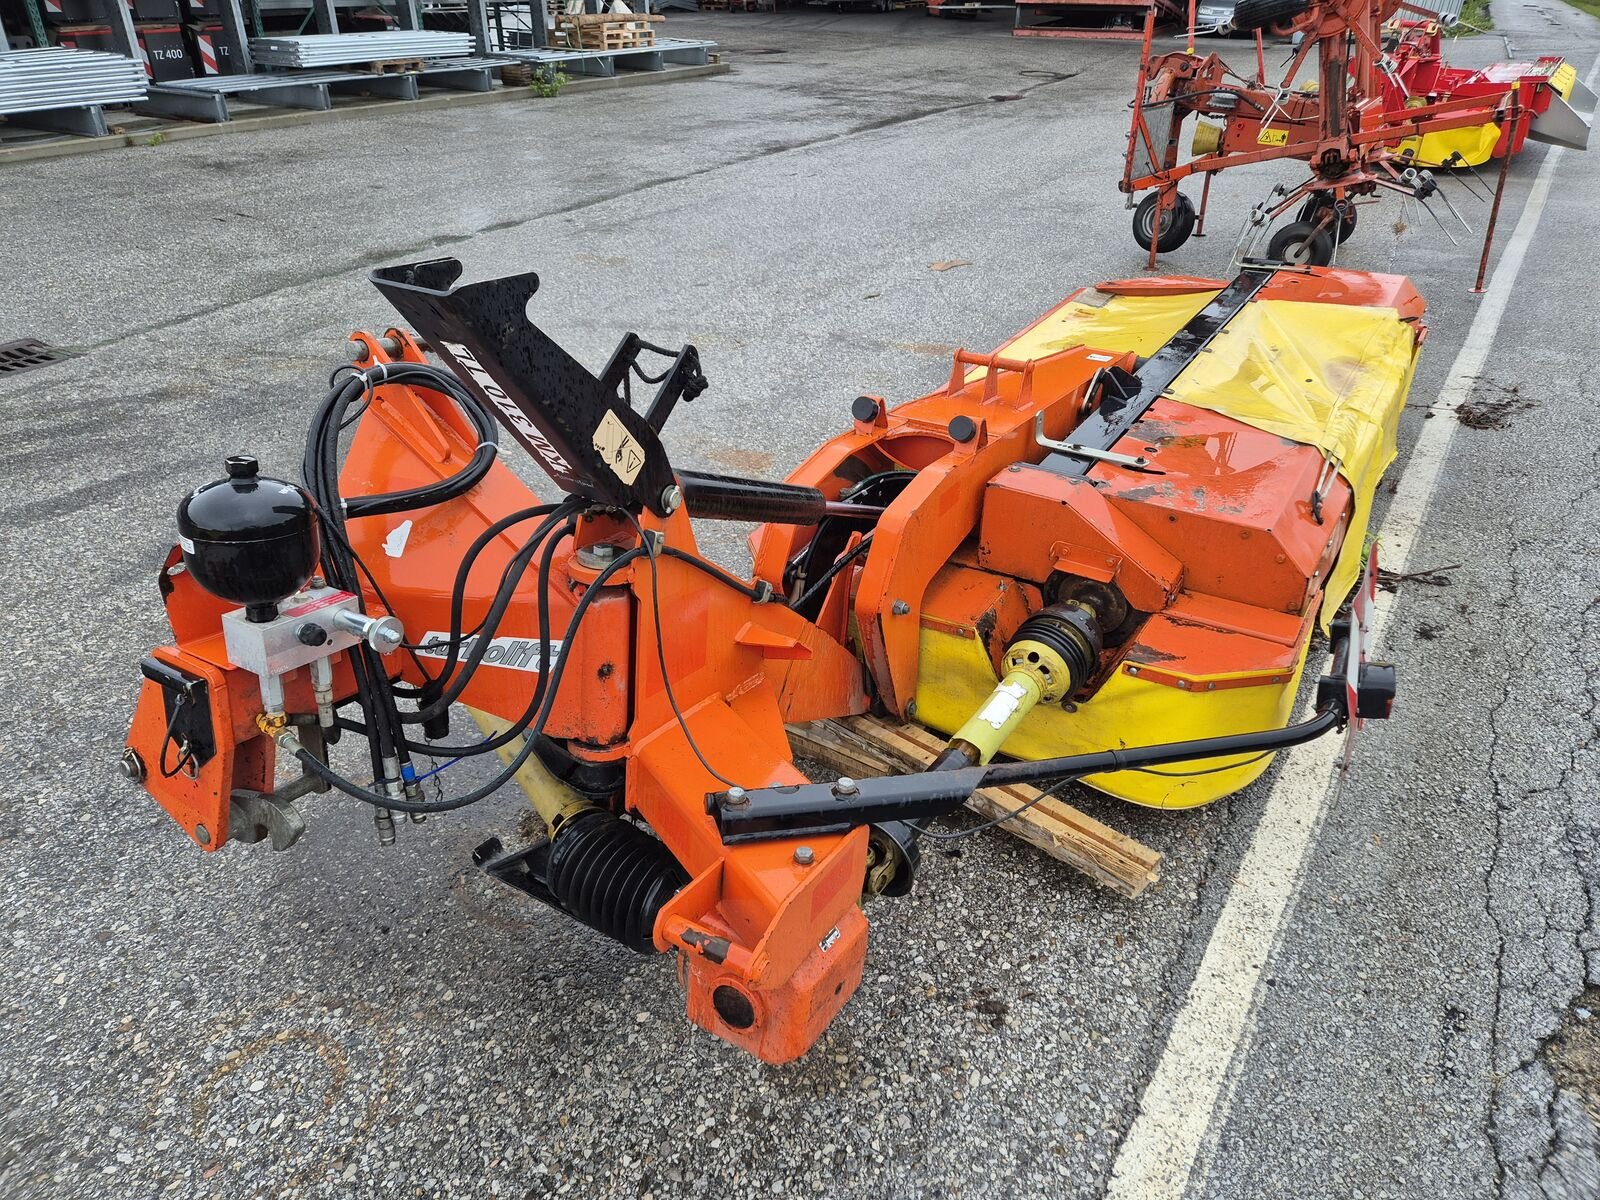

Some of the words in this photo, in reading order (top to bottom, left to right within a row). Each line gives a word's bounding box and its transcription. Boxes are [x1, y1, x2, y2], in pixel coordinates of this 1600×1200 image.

[153, 50, 165, 60] TZ
[166, 49, 183, 59] 400
[219, 46, 230, 56] TZ
[454, 347, 486, 375] TL
[484, 384, 533, 428] 310
[525, 432, 570, 473] KM
